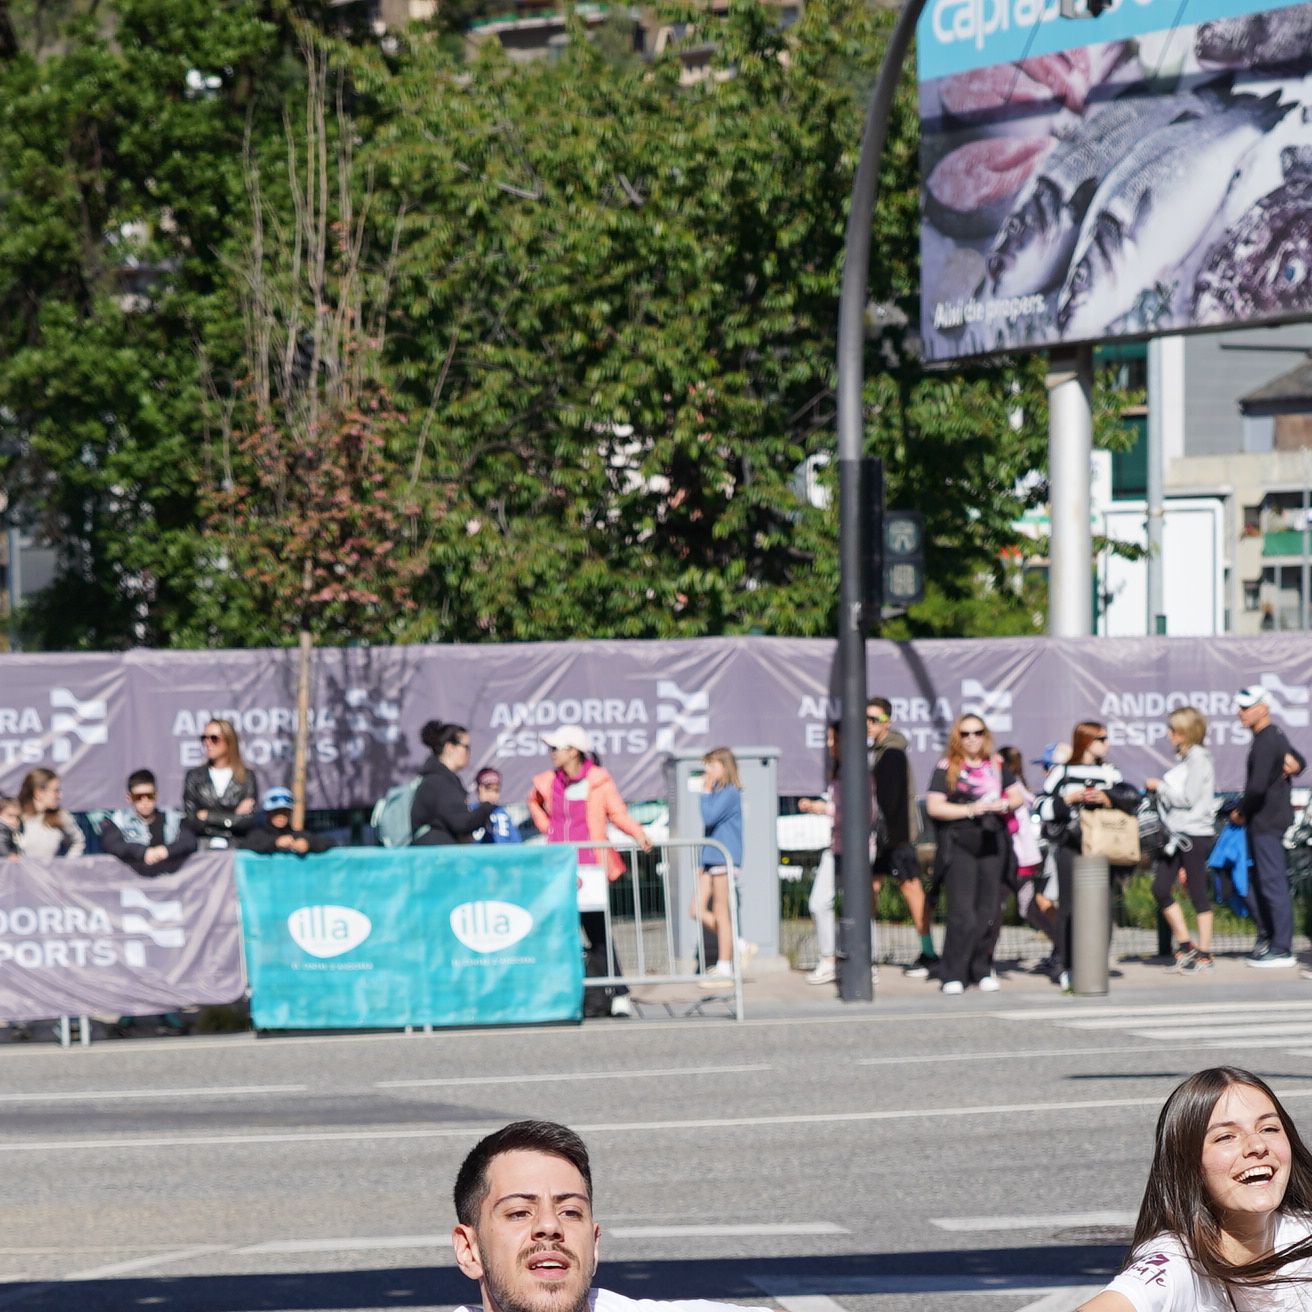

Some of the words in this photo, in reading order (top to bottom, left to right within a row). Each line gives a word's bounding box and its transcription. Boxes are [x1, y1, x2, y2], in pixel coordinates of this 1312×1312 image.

[490, 698, 650, 728] ANDORRA
[798, 695, 953, 722] ANRRA
[496, 728, 649, 758] ESRTS
[1107, 721, 1253, 746] ESPTS
[298, 905, 349, 940] illa
[460, 901, 511, 936] illa
